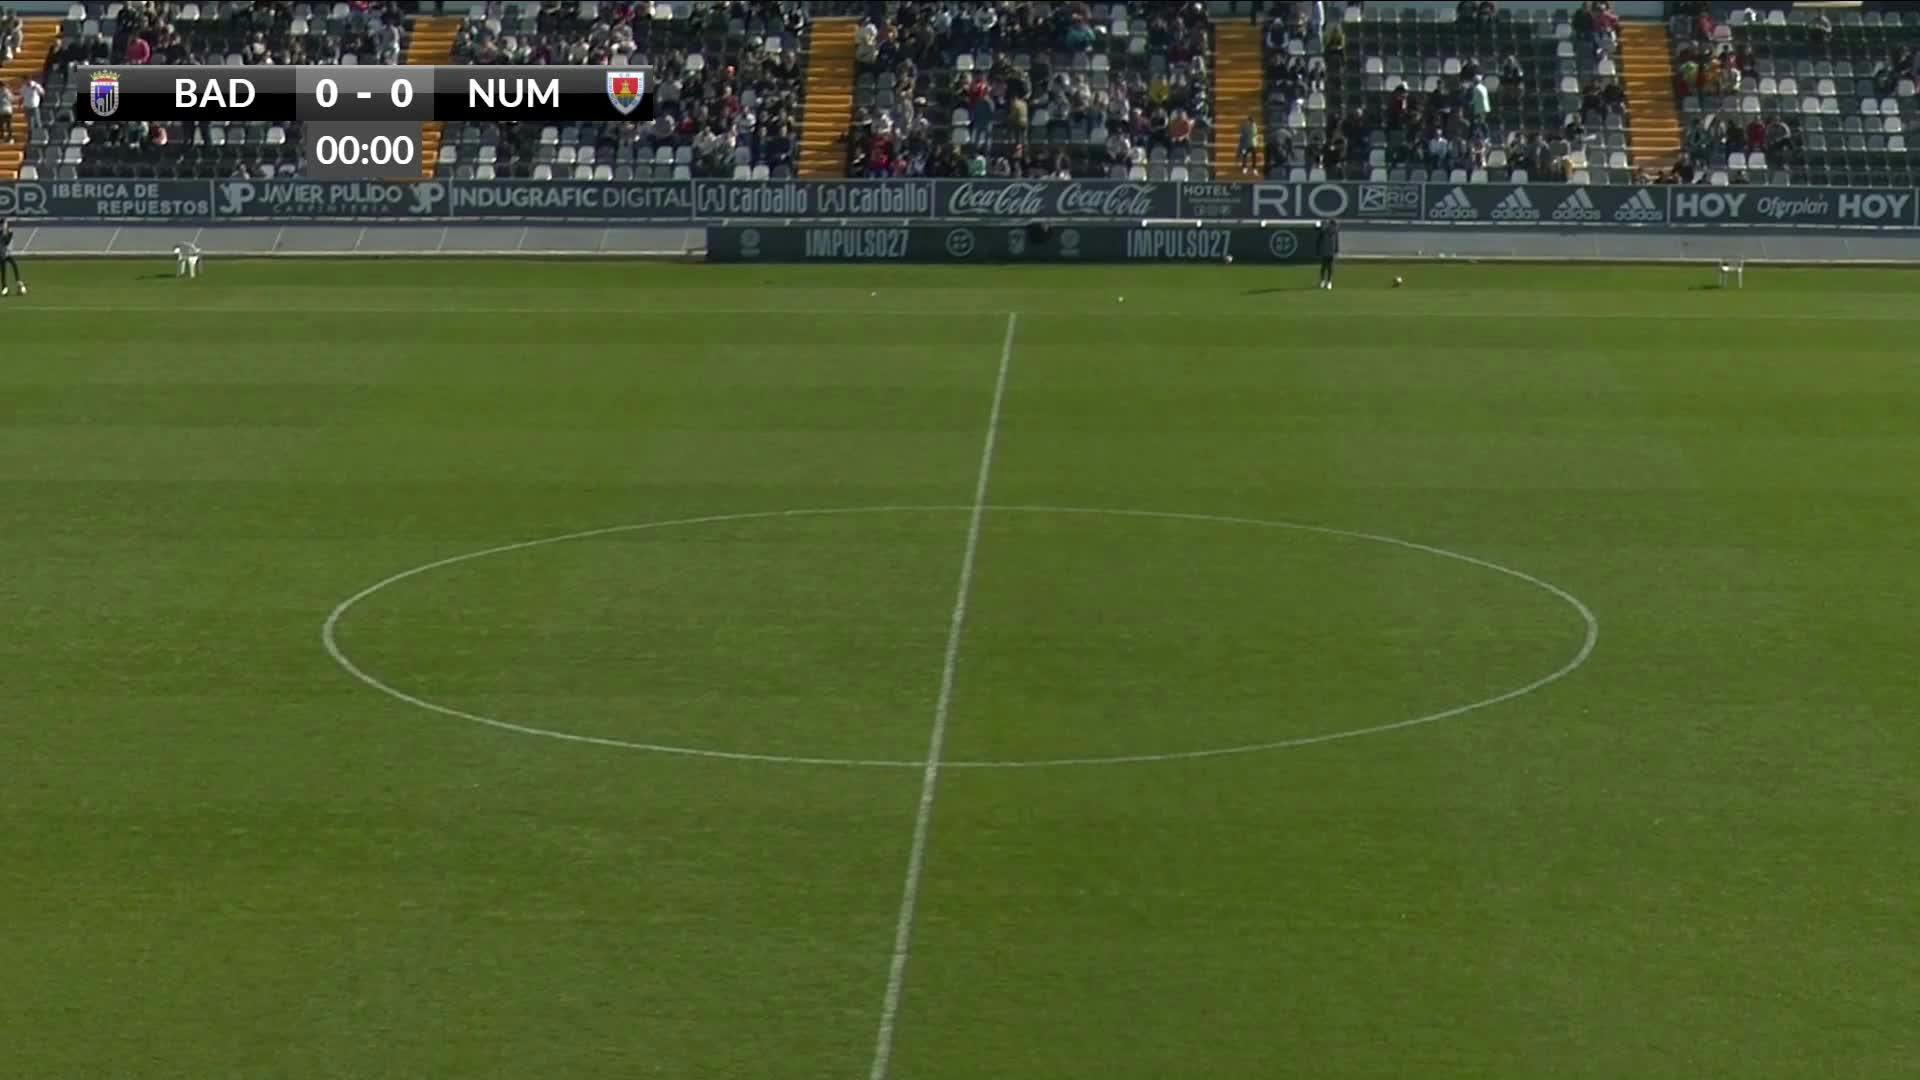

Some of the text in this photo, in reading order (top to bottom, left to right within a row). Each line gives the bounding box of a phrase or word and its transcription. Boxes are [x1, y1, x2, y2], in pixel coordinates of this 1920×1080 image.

[134, 183, 160, 199] DE
[259, 183, 403, 203] JAVIER PULIDO
[452, 186, 692, 208] INDUGRAFIC DIGITAL
[729, 183, 808, 214] carballo
[851, 183, 929, 214] carballo
[1183, 184, 1232, 196] HOTEL
[1252, 184, 1349, 217] RIO
[97, 200, 209, 215] REPUESTOS
[1429, 208, 1478, 220] adidas
[1491, 208, 1540, 220] adidas
[1552, 208, 1601, 221] adidas
[1614, 209, 1663, 221] adidas
[1676, 193, 1747, 218] HOY
[1837, 193, 1910, 219] HOY
[805, 229, 910, 257] IMPULSO27
[1126, 229, 1231, 257] IMPULSO27
